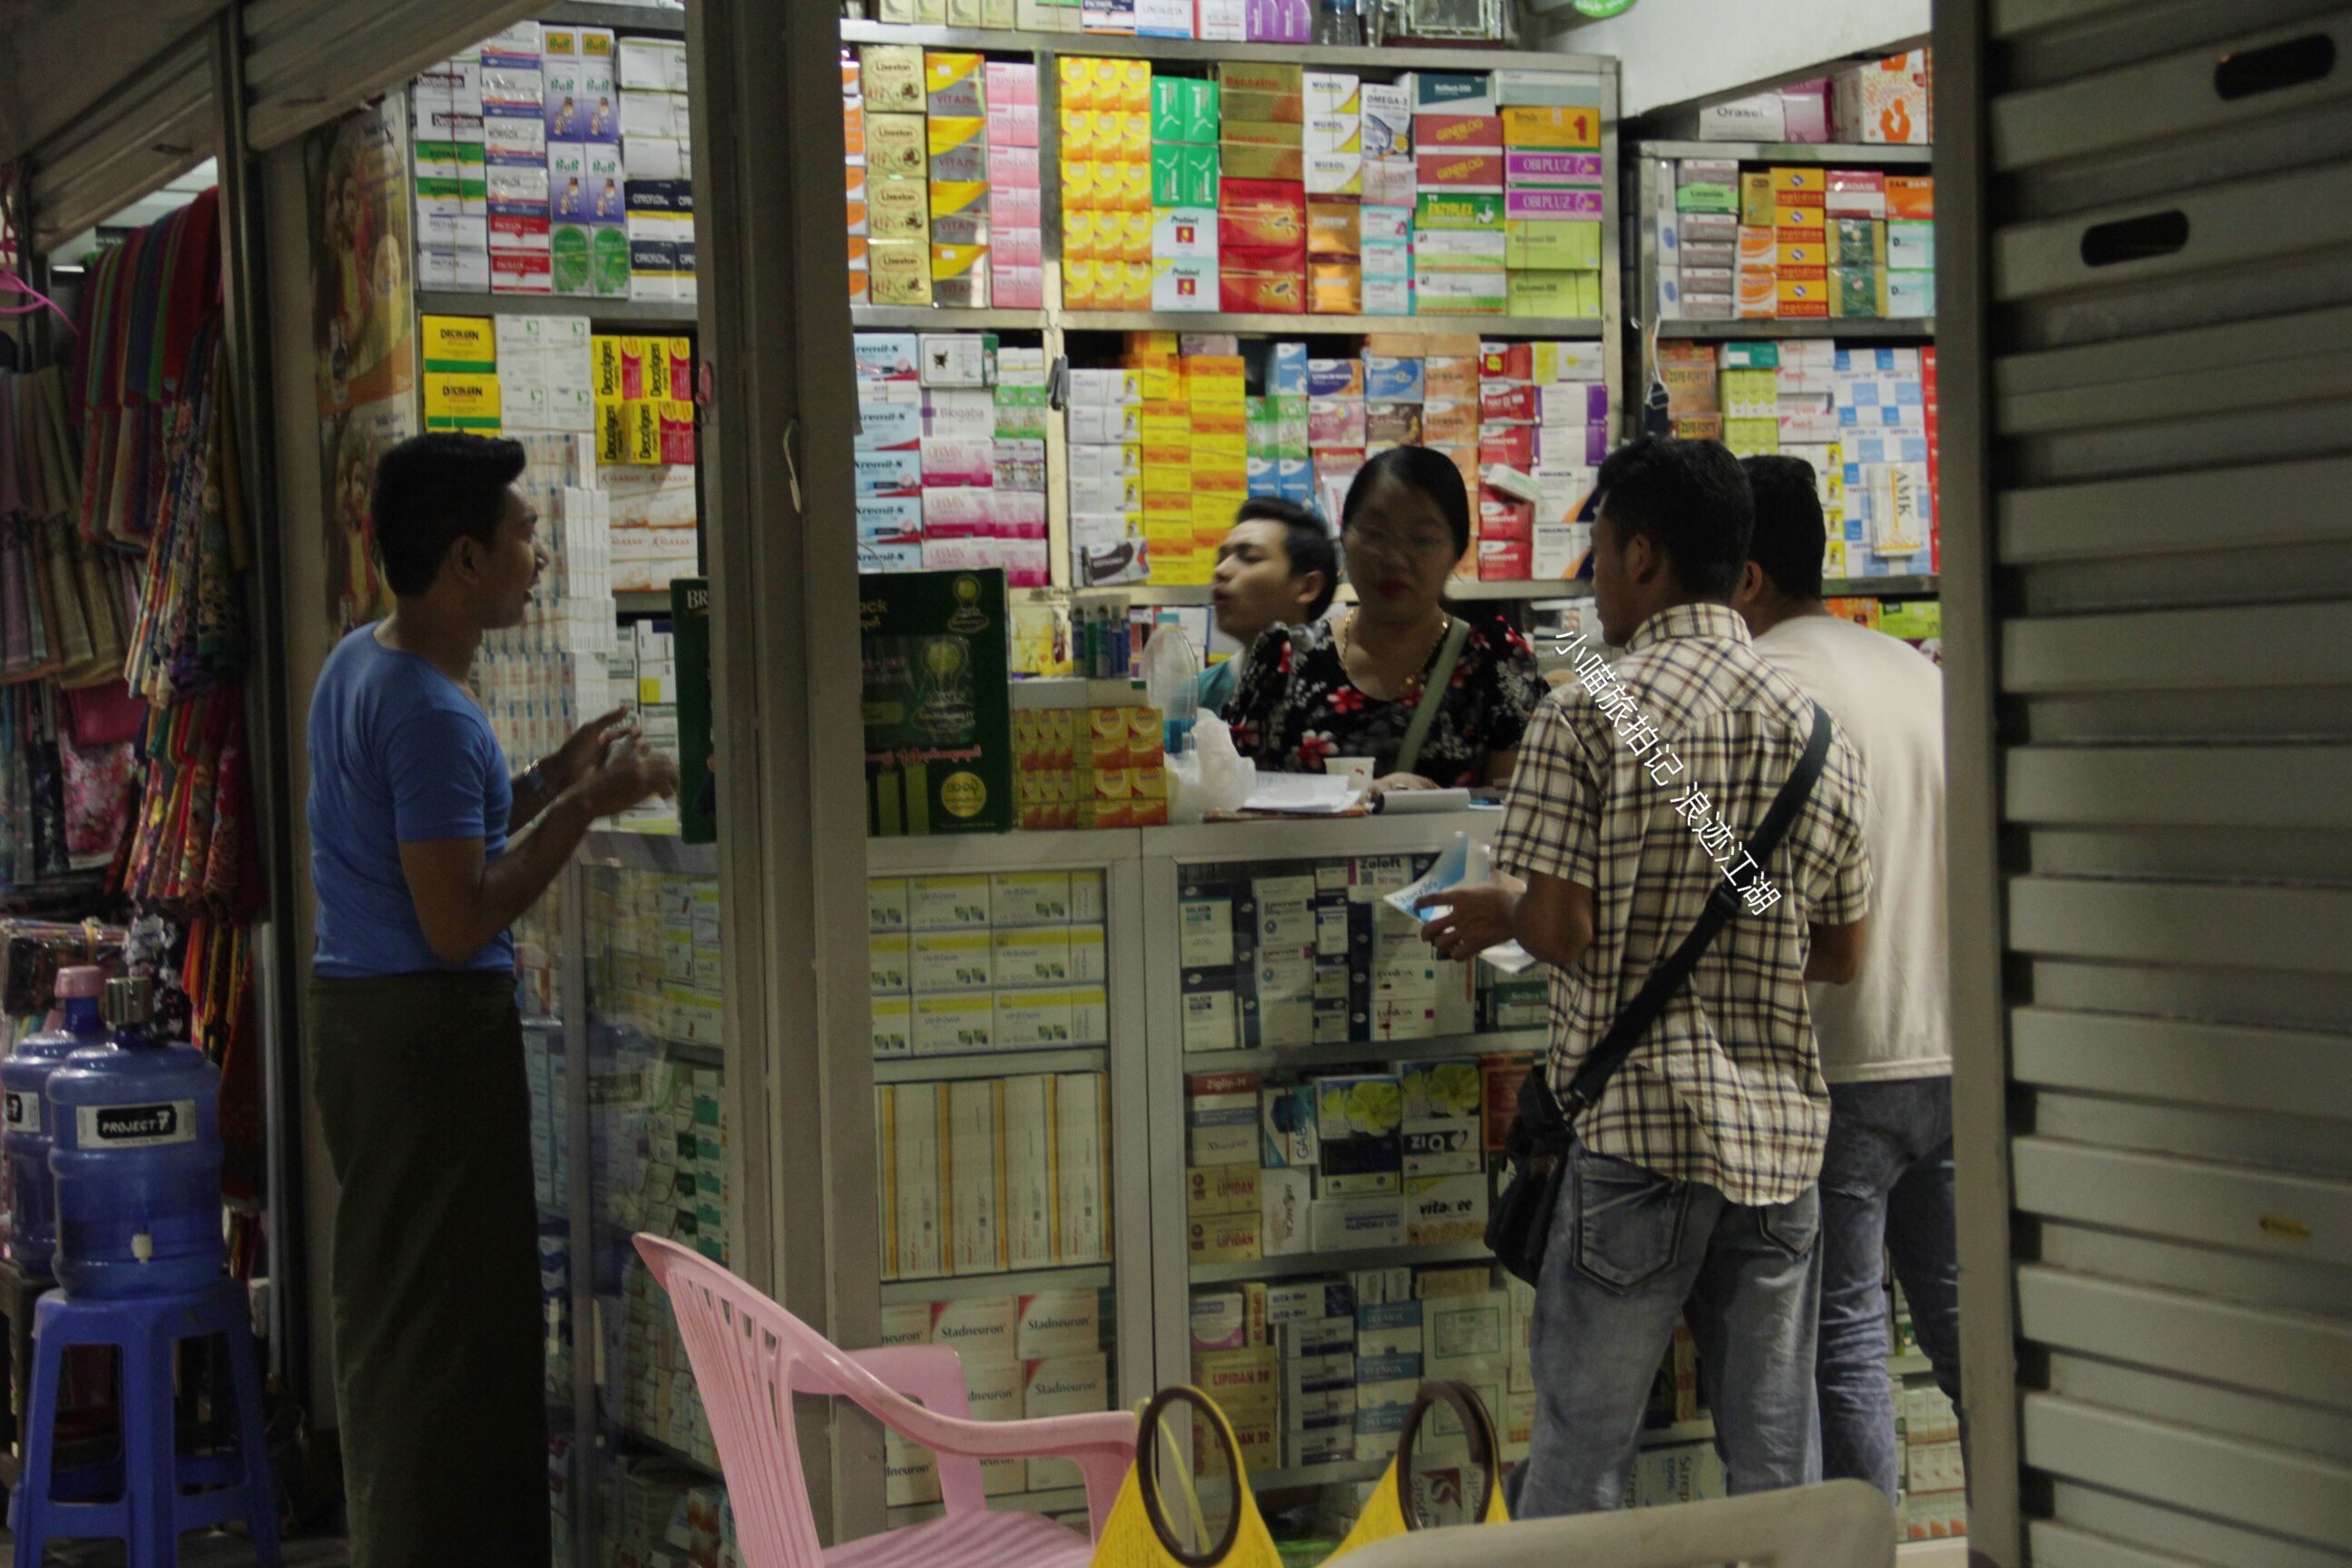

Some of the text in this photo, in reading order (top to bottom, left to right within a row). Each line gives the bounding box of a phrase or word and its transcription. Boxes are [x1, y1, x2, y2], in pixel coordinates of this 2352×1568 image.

[1573, 114, 1588, 142] 1
[1427, 202, 1473, 216] ENZYPLEX
[856, 345, 899, 353] remil-S
[1895, 470, 1914, 519] AMK
[1360, 857, 1401, 869] Zoloft
[102, 1110, 171, 1133] PROJECT 7
[941, 1323, 1005, 1338] Stadneuron
[1028, 1317, 1091, 1331] Stadneuron
[1035, 1379, 1098, 1396] Stadneuron
